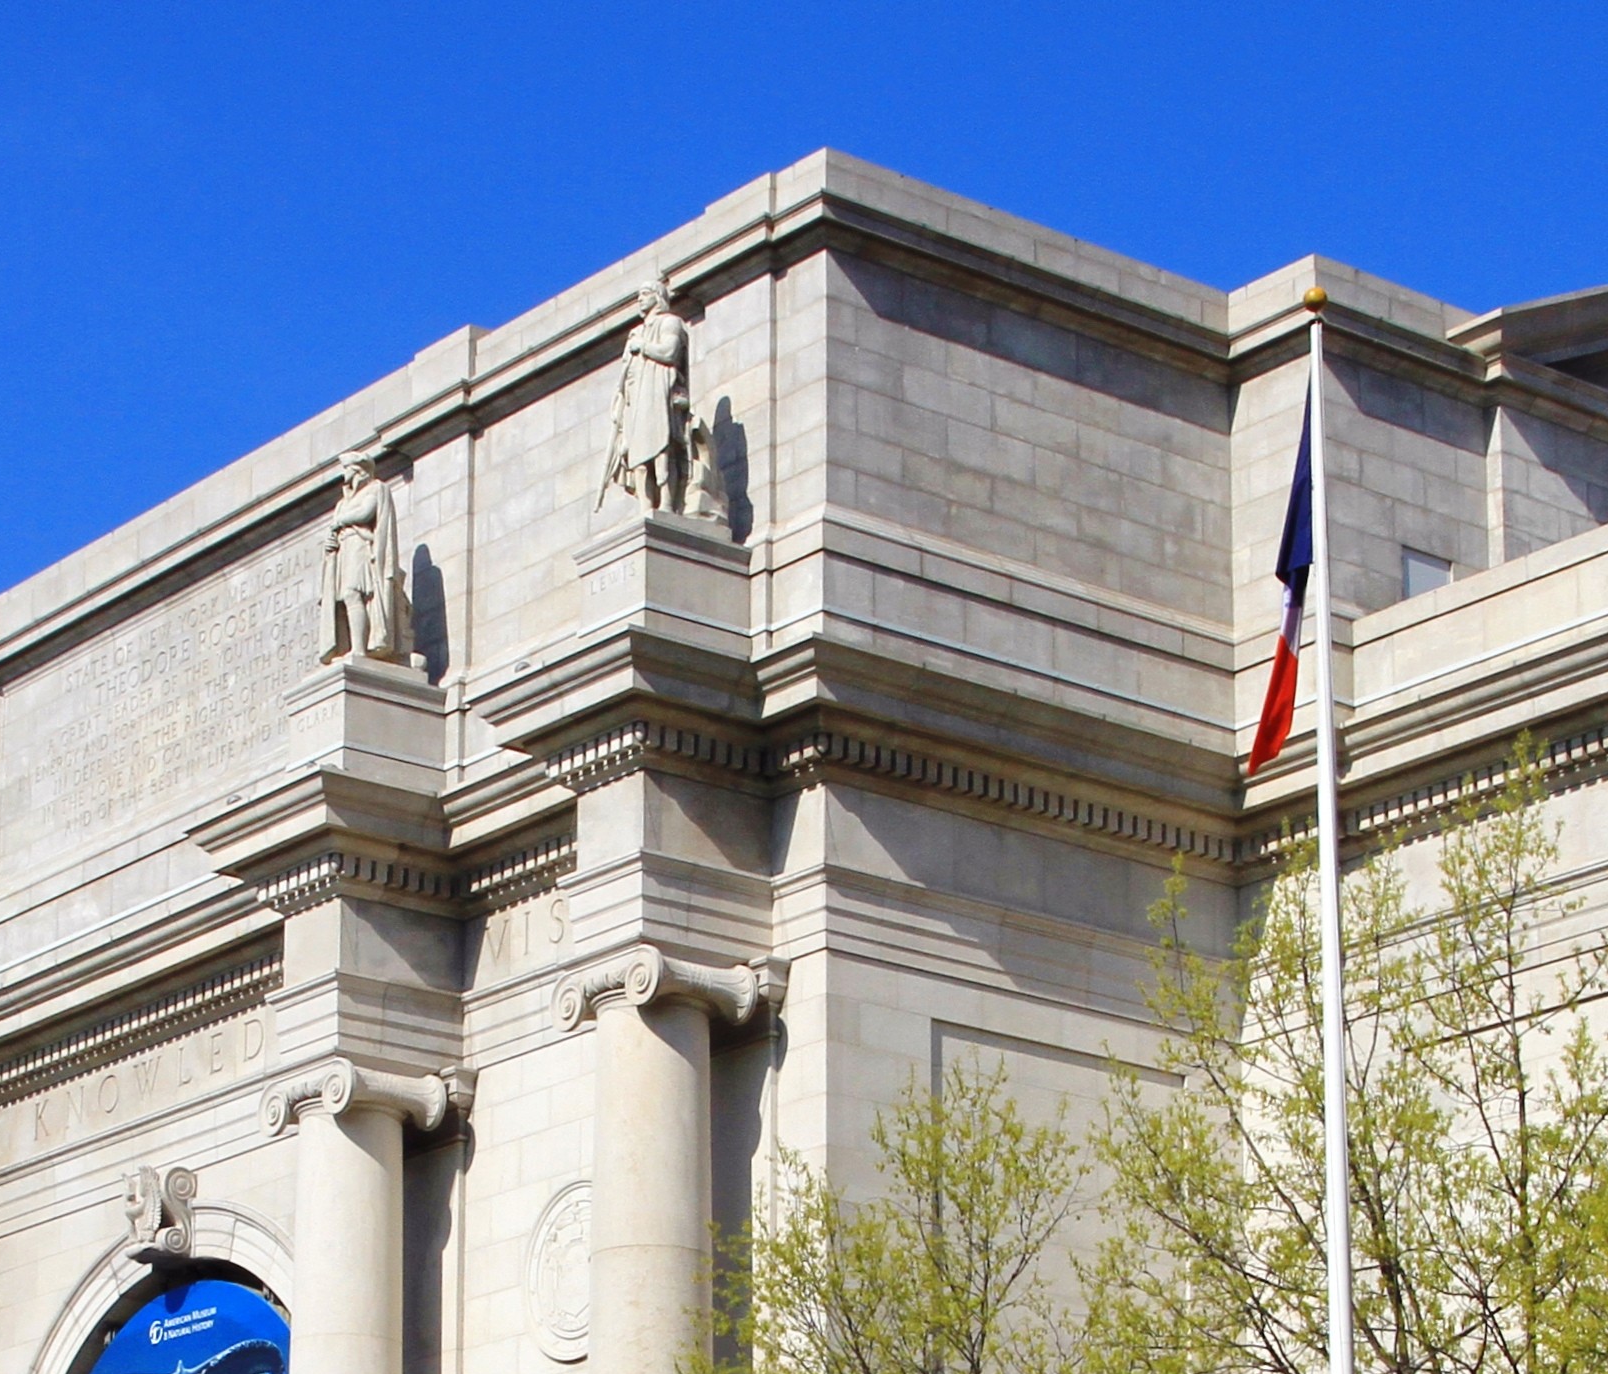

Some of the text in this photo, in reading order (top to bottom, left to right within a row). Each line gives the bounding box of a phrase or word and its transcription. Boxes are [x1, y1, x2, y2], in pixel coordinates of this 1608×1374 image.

[95, 578, 305, 707] THEODORE ROOSEVELT
[114, 641, 133, 667] OF
